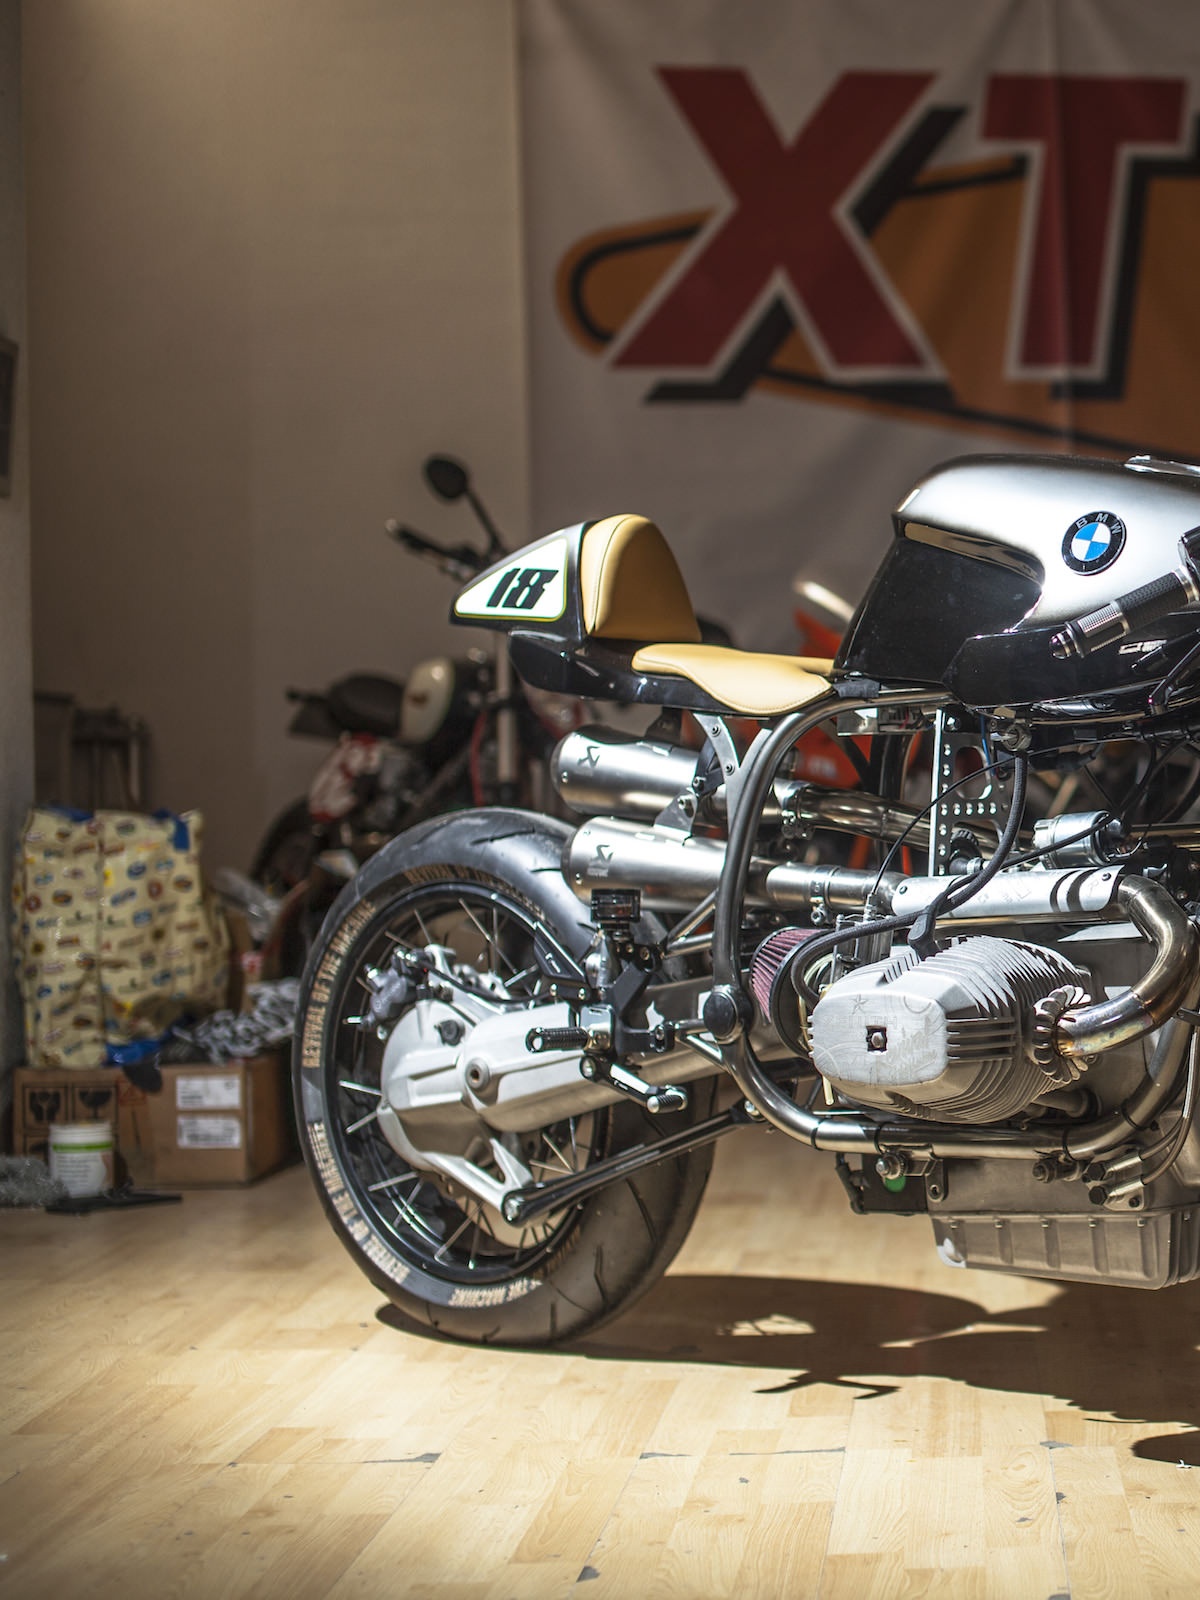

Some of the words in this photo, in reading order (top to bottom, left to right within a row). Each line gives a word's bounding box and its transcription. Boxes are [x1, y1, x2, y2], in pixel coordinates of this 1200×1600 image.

[1075, 512, 1122, 535] BMW
[486, 567, 559, 610] 18
[330, 899, 377, 955] MACHINE
[316, 951, 342, 982] THE
[311, 980, 332, 1003] OF
[302, 1005, 326, 1068] REVIVAL
